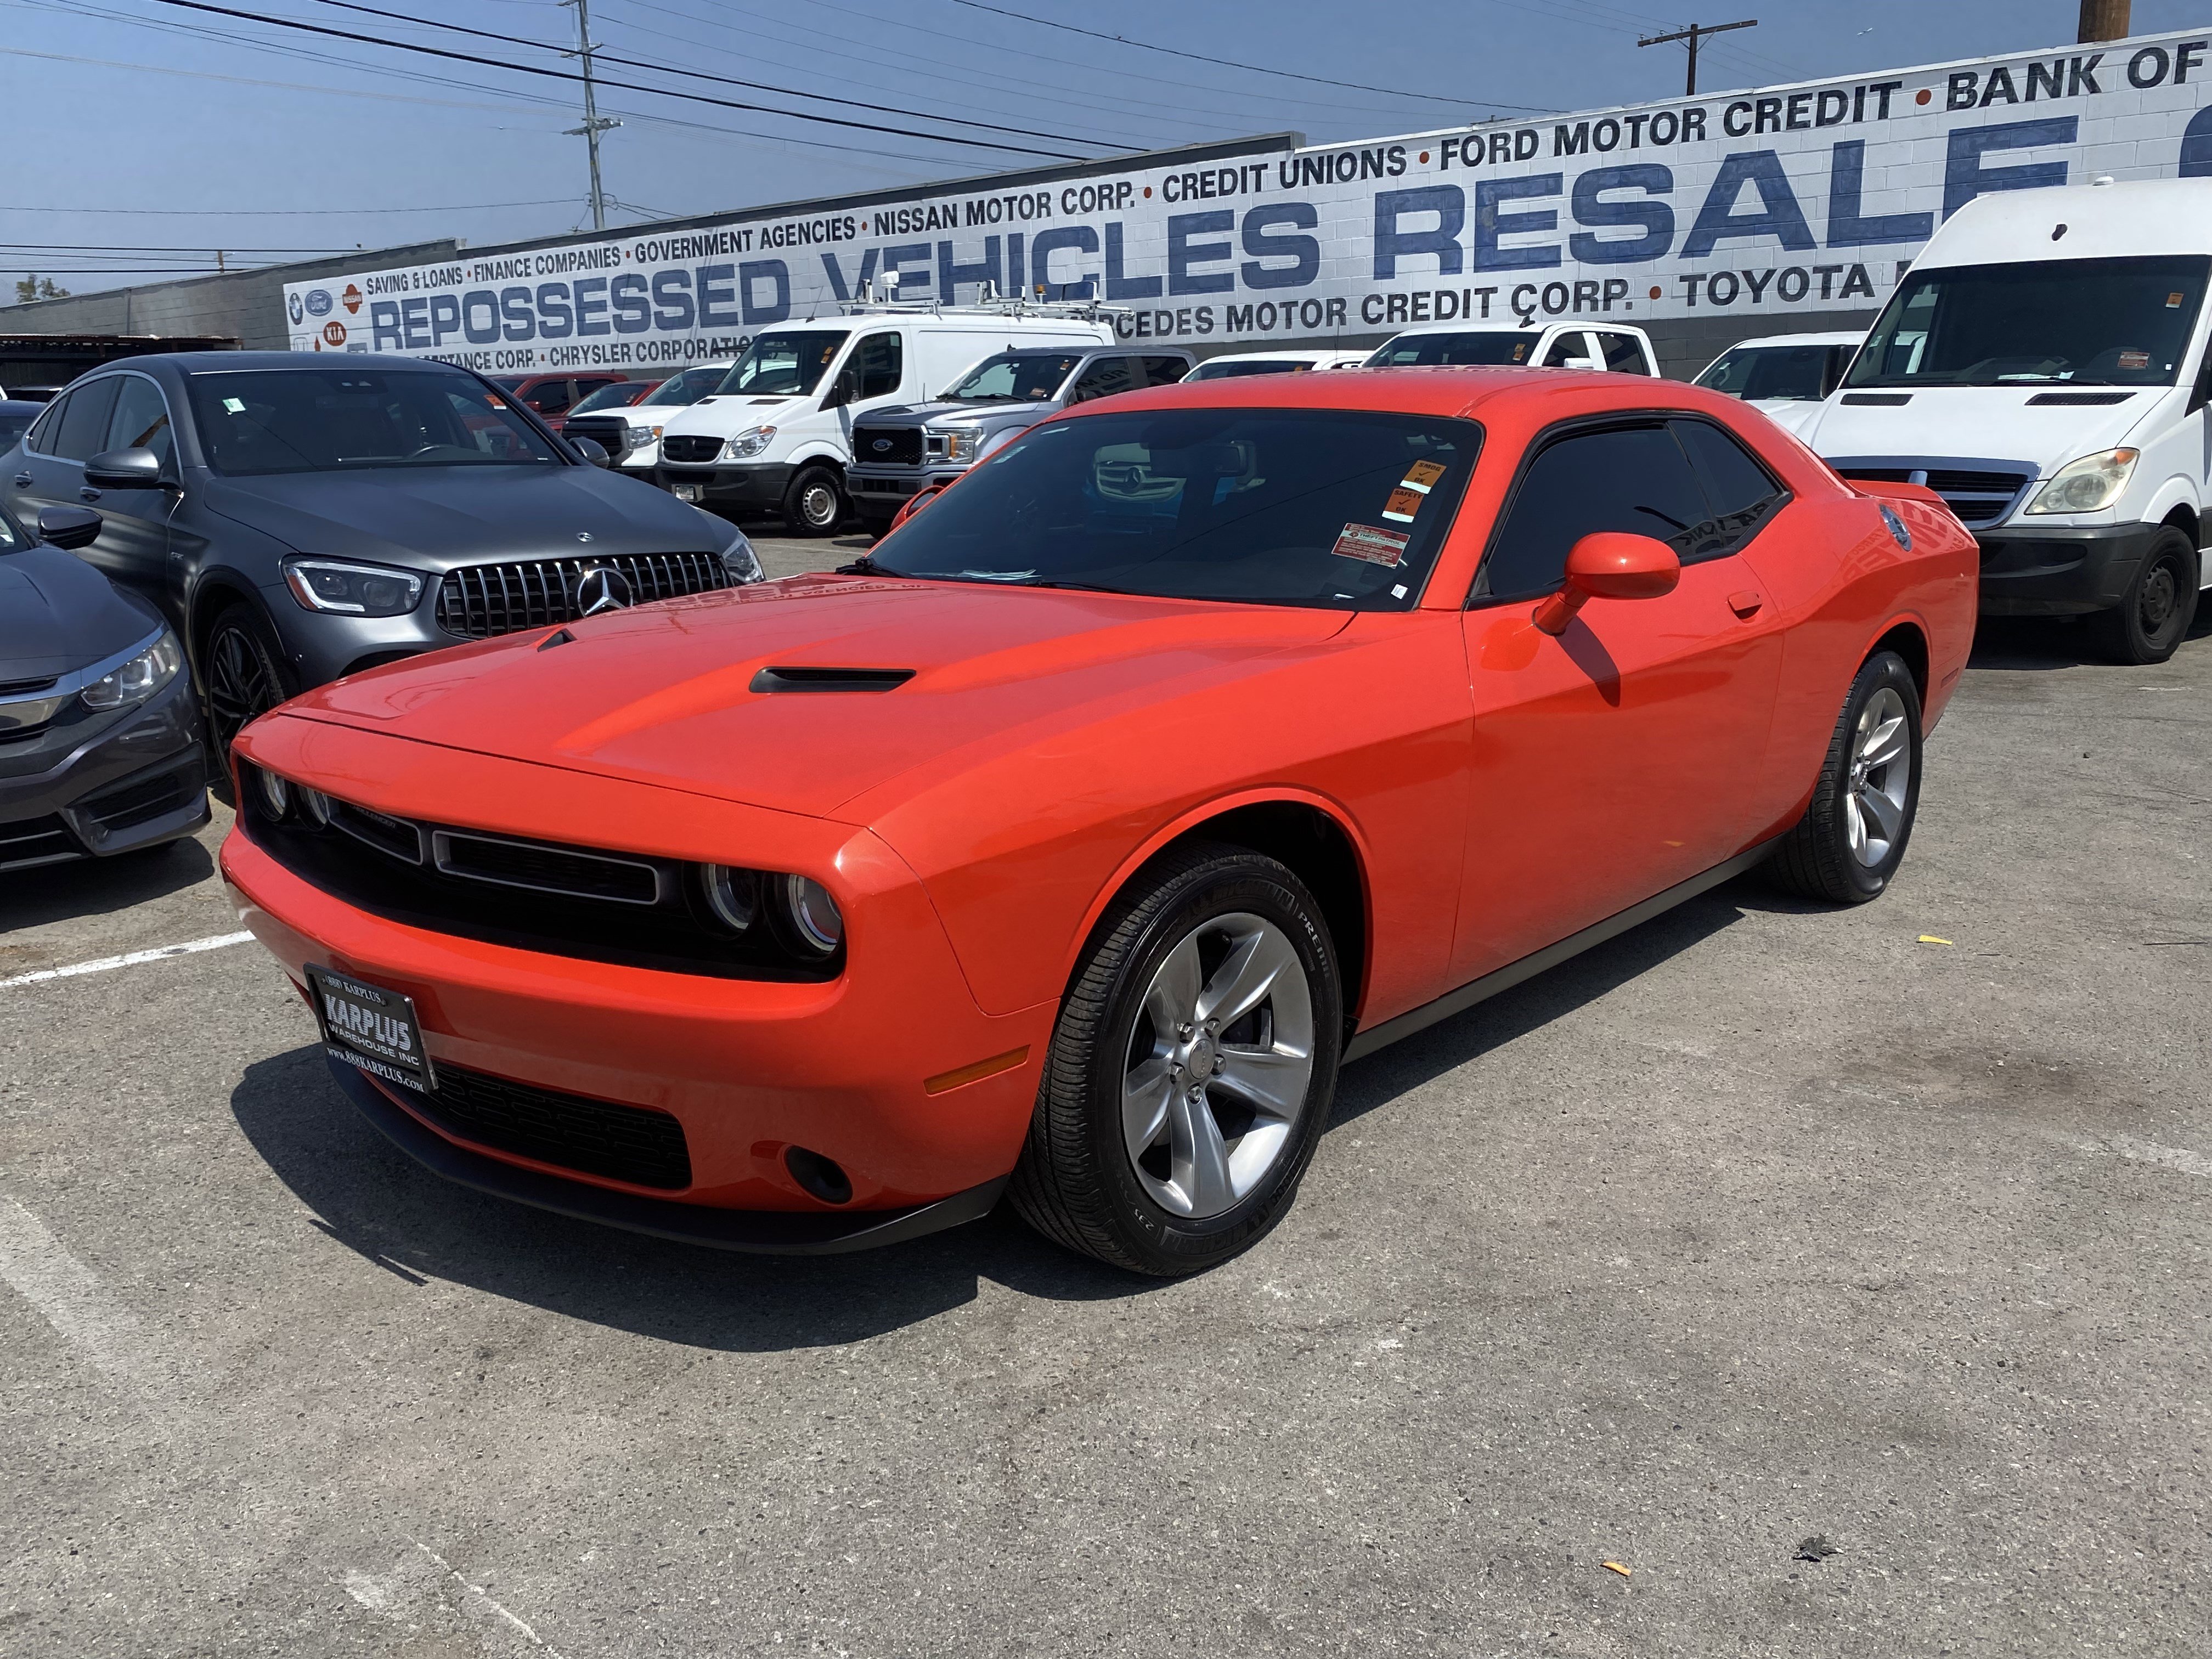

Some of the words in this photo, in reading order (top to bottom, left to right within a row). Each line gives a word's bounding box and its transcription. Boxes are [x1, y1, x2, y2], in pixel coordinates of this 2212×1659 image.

[366, 273, 408, 295] SAVING
[423, 267, 462, 288] LOANS
[474, 258, 531, 281] FINANCE
[536, 246, 620, 273] COMPANIES
[635, 229, 753, 263] GOVERNMENT
[760, 217, 855, 249] AGENCIES
[875, 203, 957, 236] NISSAN
[966, 192, 1051, 225] MOTOR
[1062, 182, 1135, 215] CORP.
[1163, 163, 1268, 202] CREDIT
[1280, 146, 1407, 189] UNIONS
[1441, 129, 1538, 170] FORD
[1554, 108, 1707, 156] MOTOR
[1724, 81, 1902, 137] CREDIT
[1946, 53, 2106, 111] BANK
[2128, 41, 2208, 89] OF
[371, 259, 791, 351] REPOSSESSED
[821, 202, 1319, 315] VEHICLES
[1374, 115, 2079, 280] RESALE
[1227, 298, 1347, 332] MOTOR
[1362, 287, 1498, 324] CREDIT
[1511, 279, 1633, 317] CORP.
[1680, 264, 1875, 307] TOYOTA
[495, 349, 535, 369] CORP.
[550, 343, 631, 366] CHRYSLER
[637, 336, 756, 362] CORPORATIO
[1418, 462, 1441, 472] SMOG
[1394, 490, 1423, 499] SAFETY
[325, 975, 342, 990] (888)
[343, 981, 381, 1003] KARPLUS
[324, 994, 411, 1051] KARPLUS
[328, 1023, 396, 1058] WAREHOUSE
[398, 1052, 420, 1066] INC
